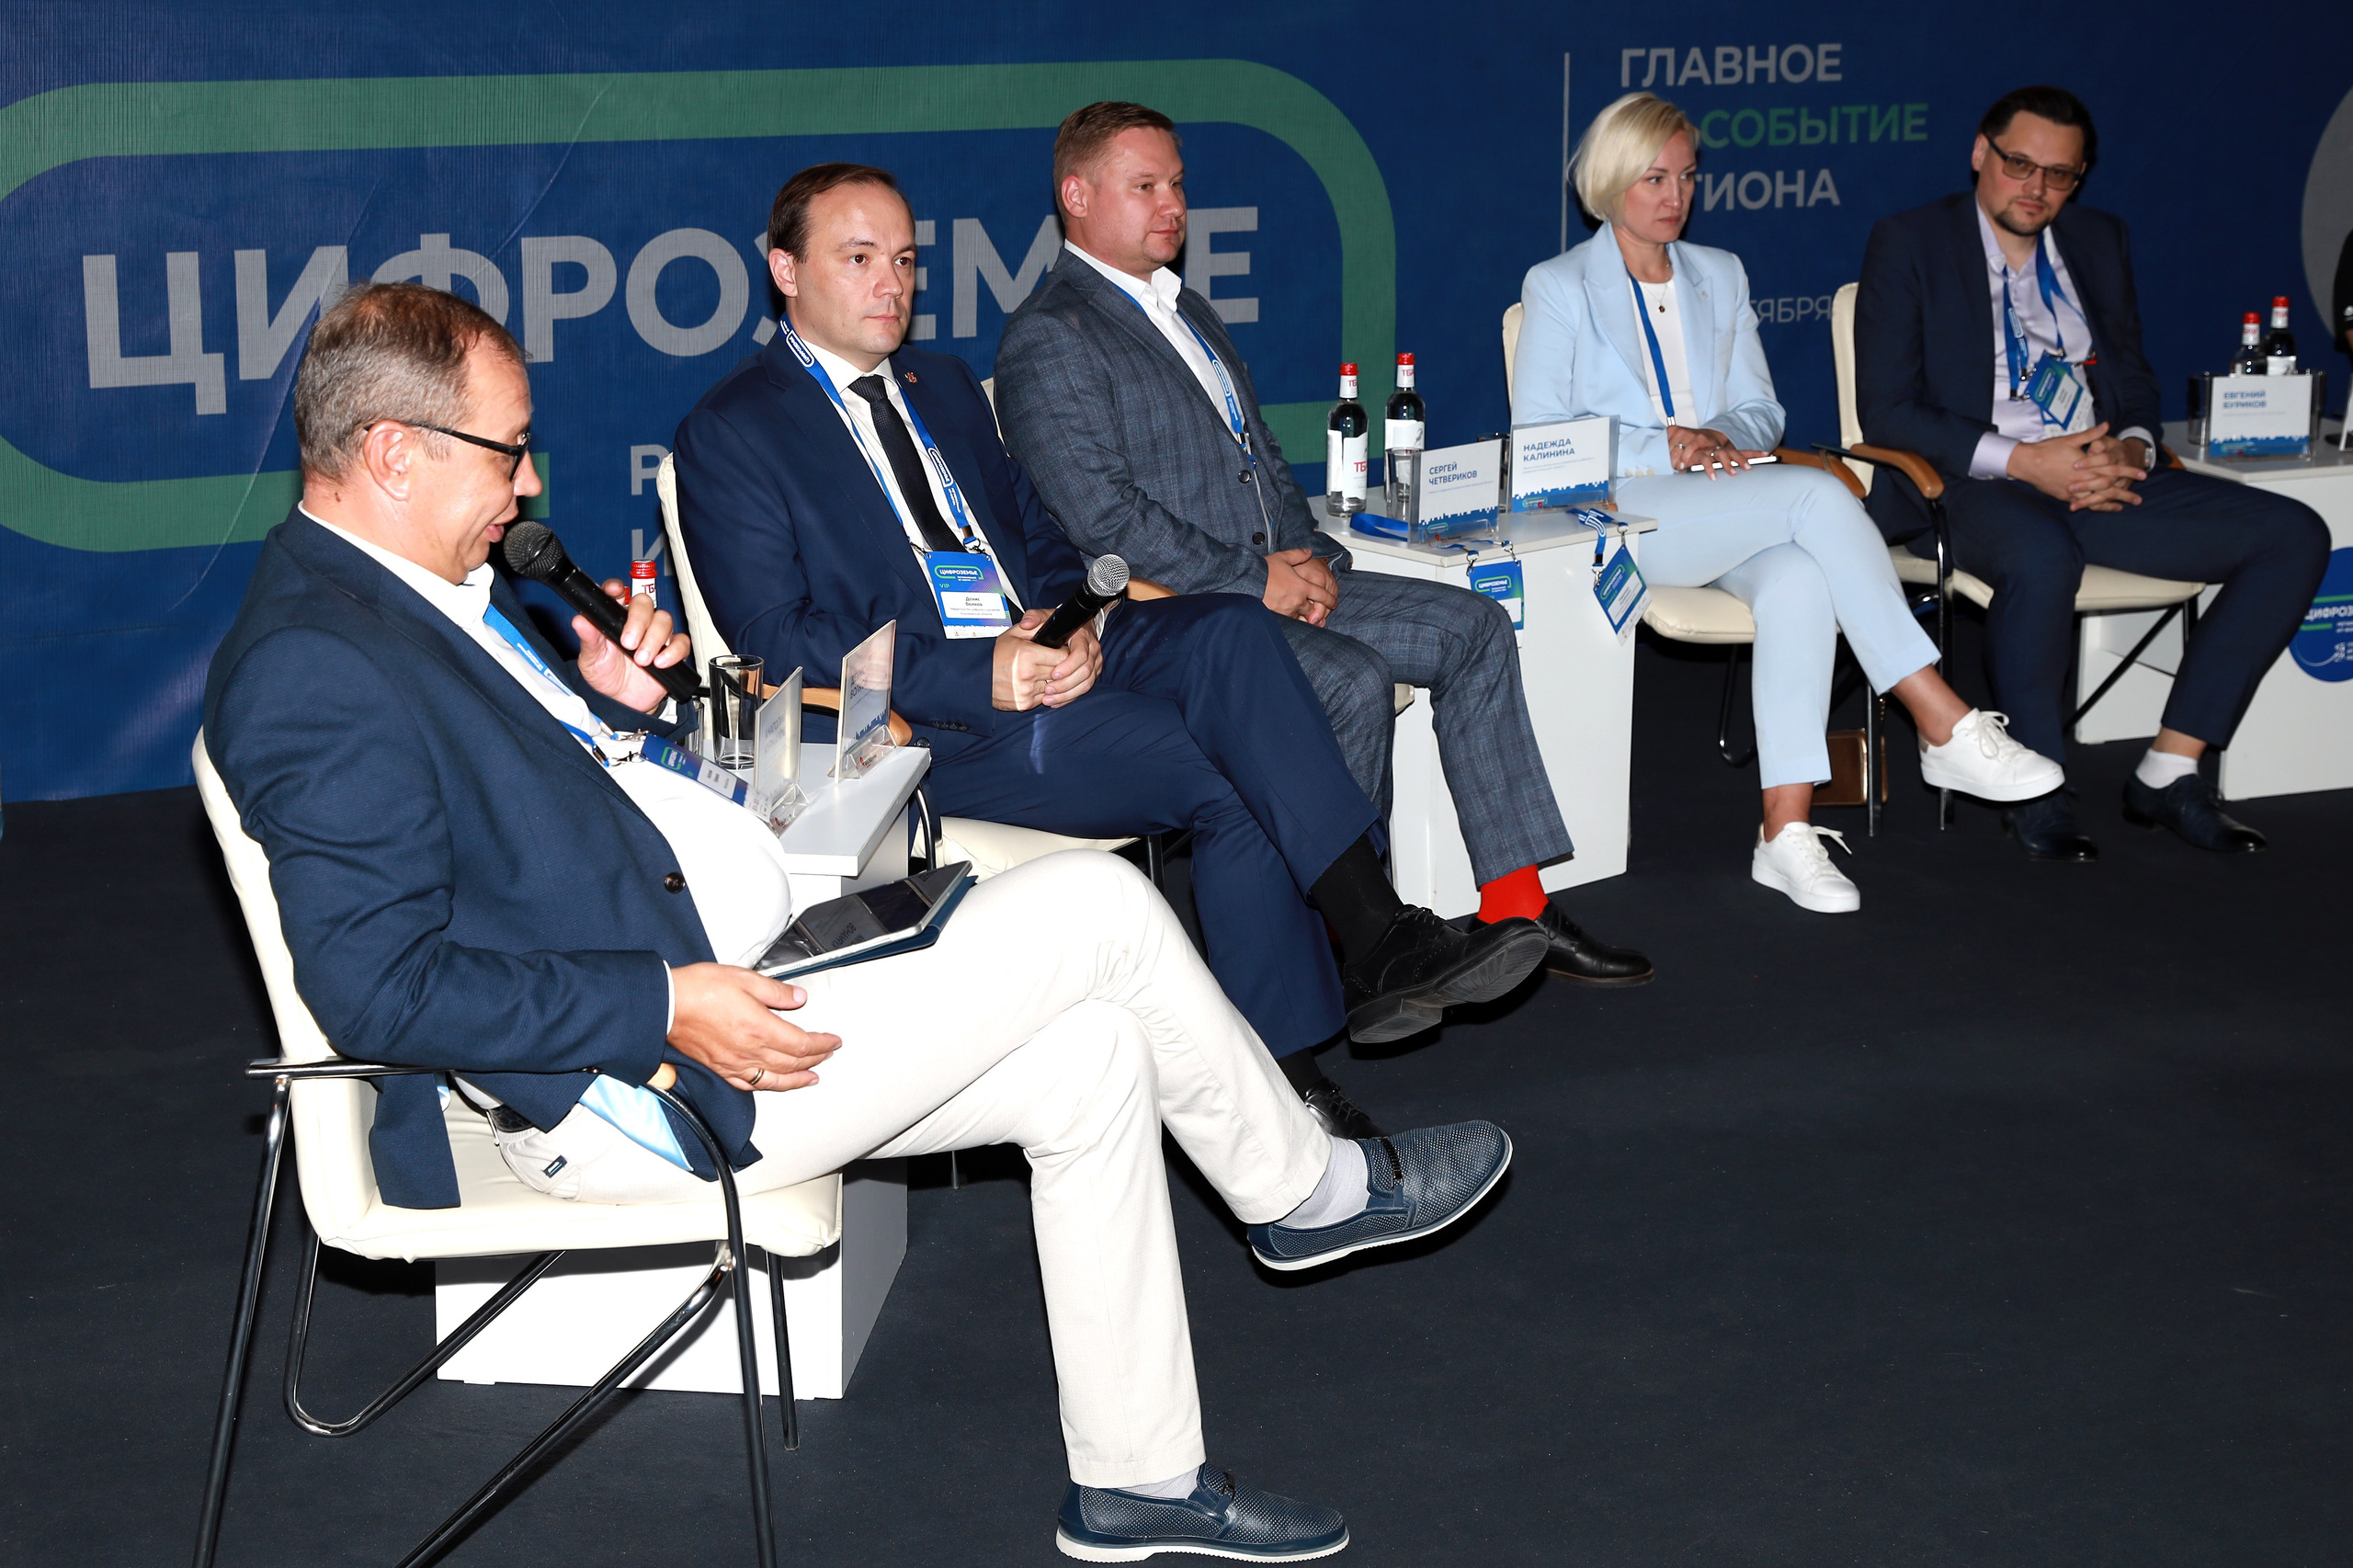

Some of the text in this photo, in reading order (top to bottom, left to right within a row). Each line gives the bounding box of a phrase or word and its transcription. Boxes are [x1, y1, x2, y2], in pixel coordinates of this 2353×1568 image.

[1620, 43, 1843, 87] ГЛАВНОЕ
[1695, 168, 1841, 211] ИОНА
[2223, 390, 2267, 399] ЕВГЕНИЙ
[1523, 438, 1572, 451] НАДЕЖДА
[1523, 448, 1575, 461] КАЛИНИНА
[1353, 461, 1368, 473] ТБ
[1429, 461, 1458, 475] СЕРГЕЙ
[1428, 471, 1478, 485] ЧЕТВЕРИКОВ
[641, 583, 656, 595] ТБ
